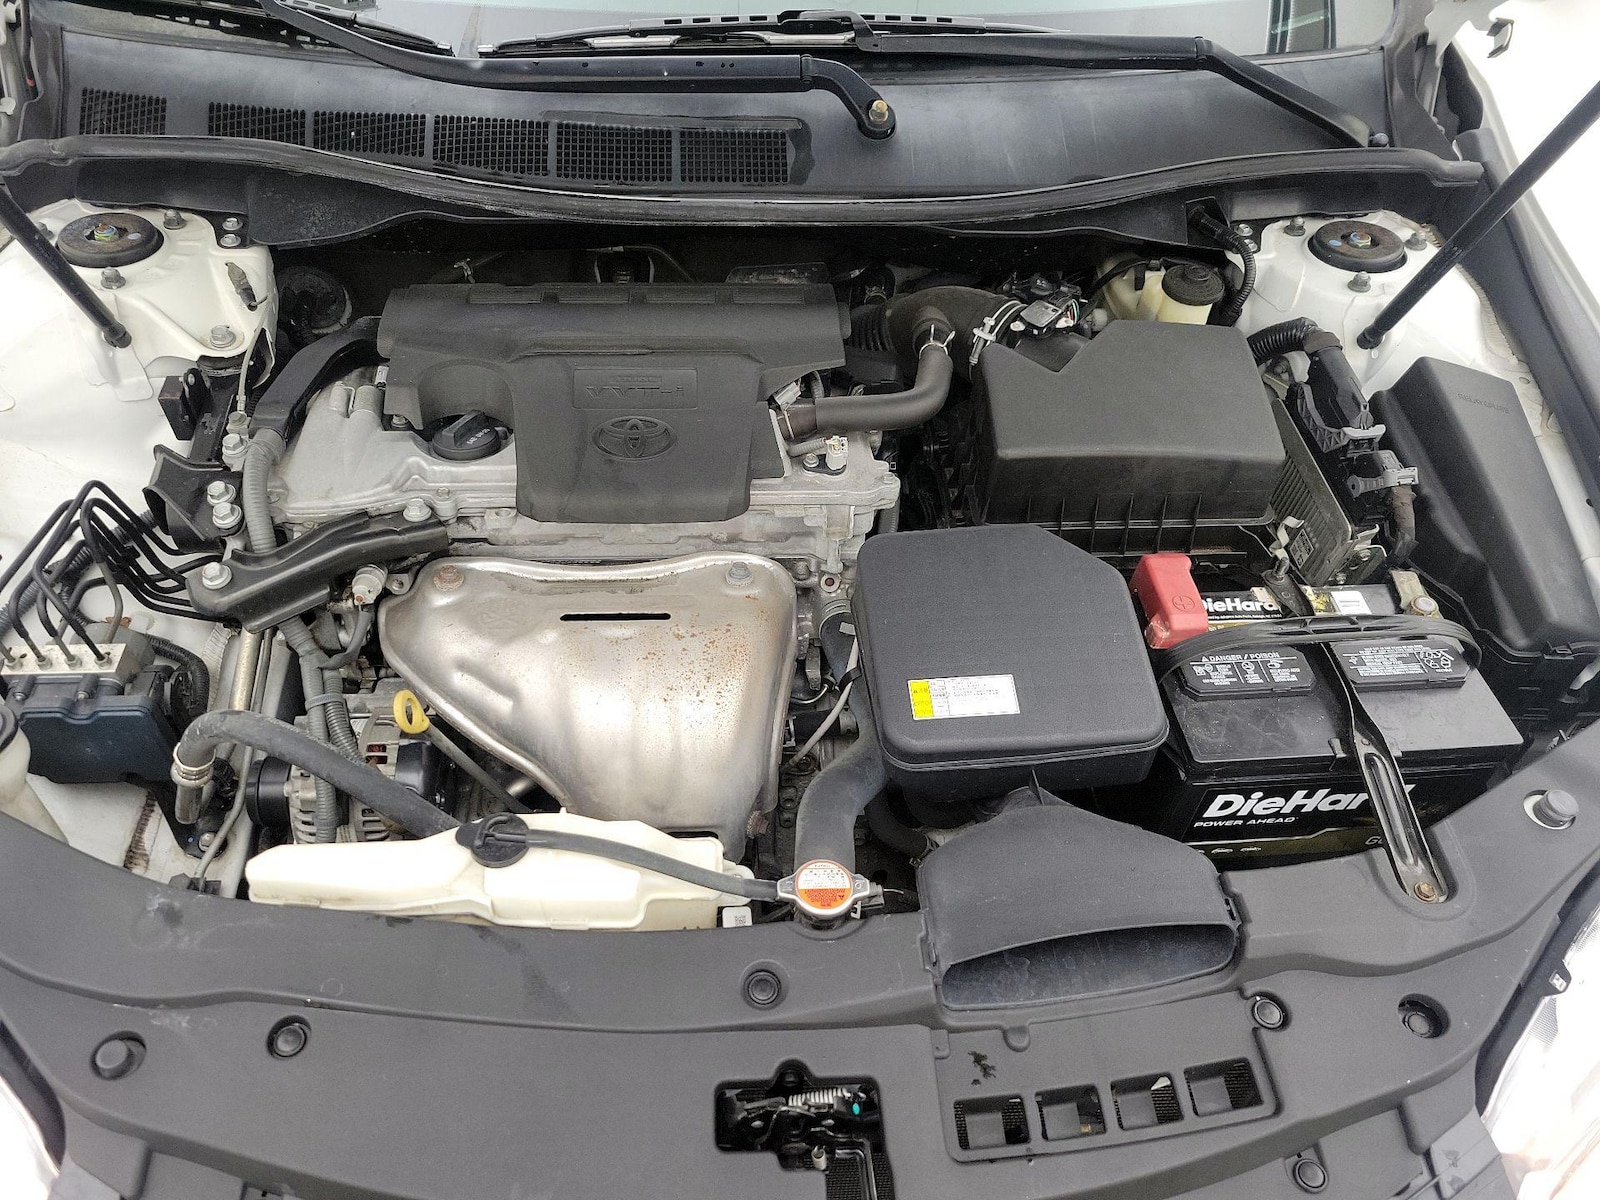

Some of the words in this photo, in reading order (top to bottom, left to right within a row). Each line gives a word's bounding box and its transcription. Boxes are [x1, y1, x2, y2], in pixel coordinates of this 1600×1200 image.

[586, 386, 685, 399] VVT-i
[1203, 784, 1416, 818] DieHar
[1193, 820, 1243, 828] POWER
[1246, 817, 1295, 825] AHEAD
